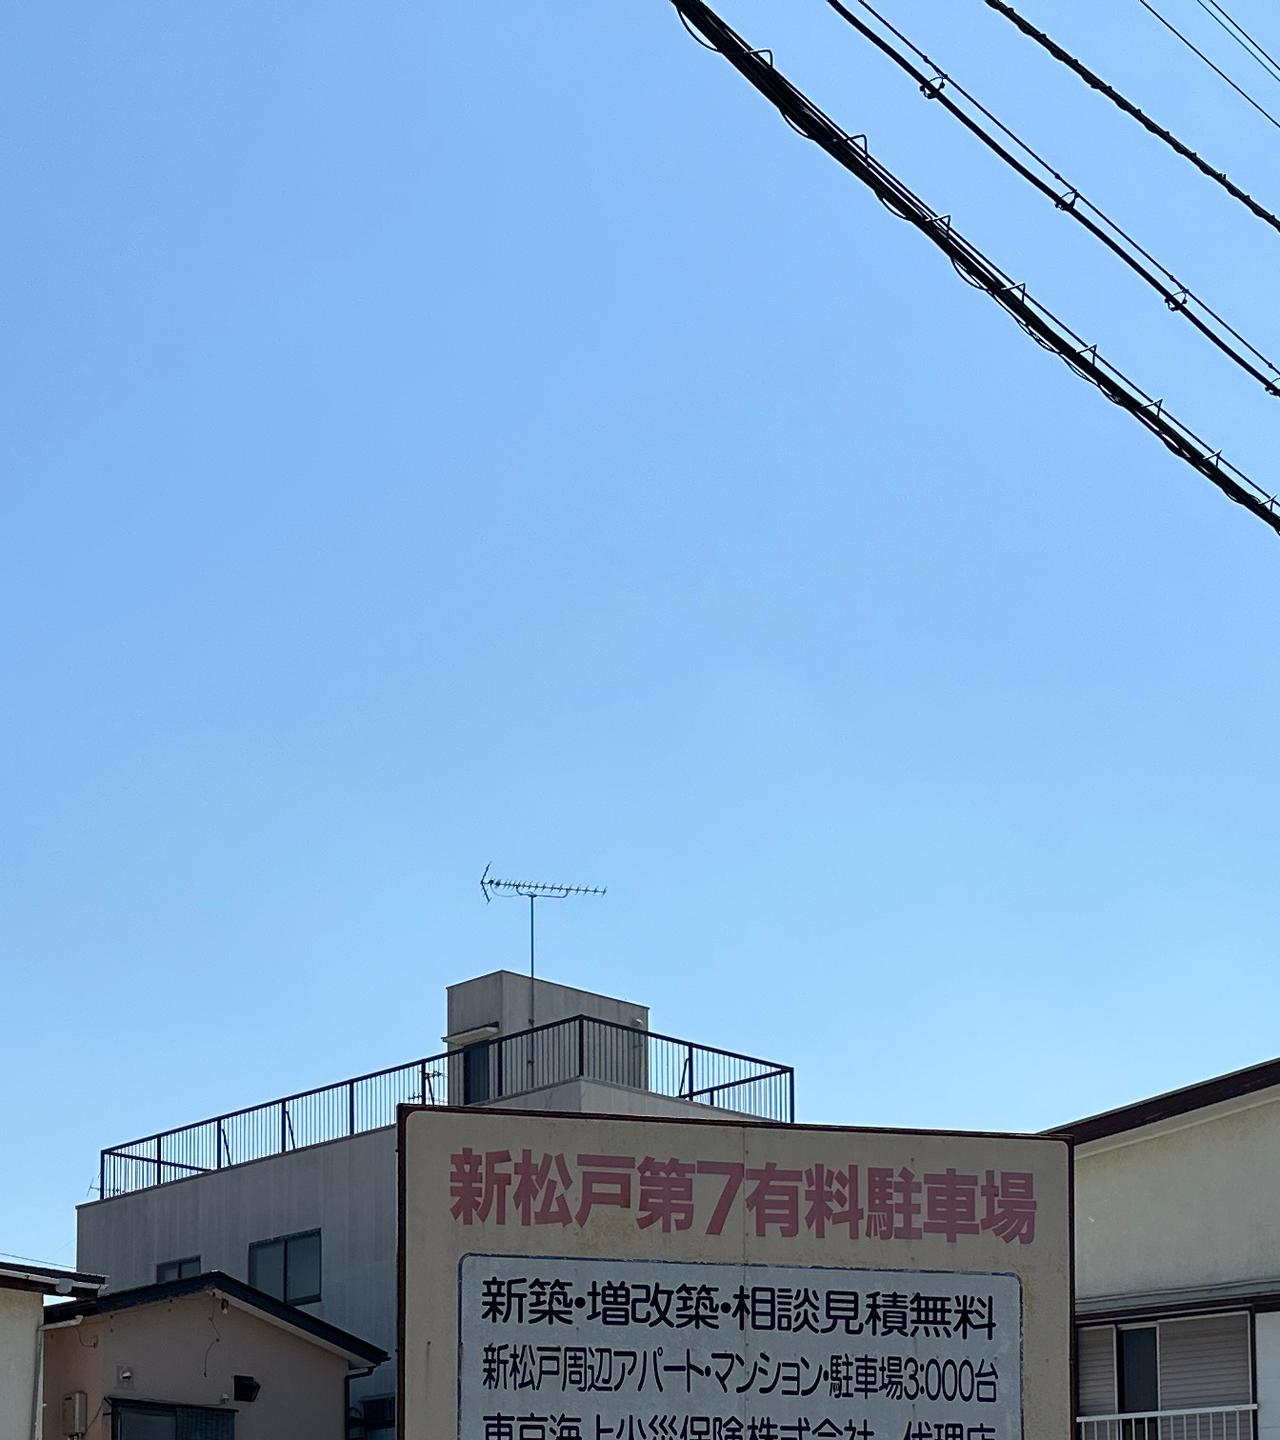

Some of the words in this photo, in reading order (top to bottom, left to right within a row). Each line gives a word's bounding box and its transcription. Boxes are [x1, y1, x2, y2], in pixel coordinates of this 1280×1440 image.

[448, 1146, 1038, 1245] 新松戸第7有料駐車場
[481, 1275, 997, 1341] 新築・増改築・相談見積無料
